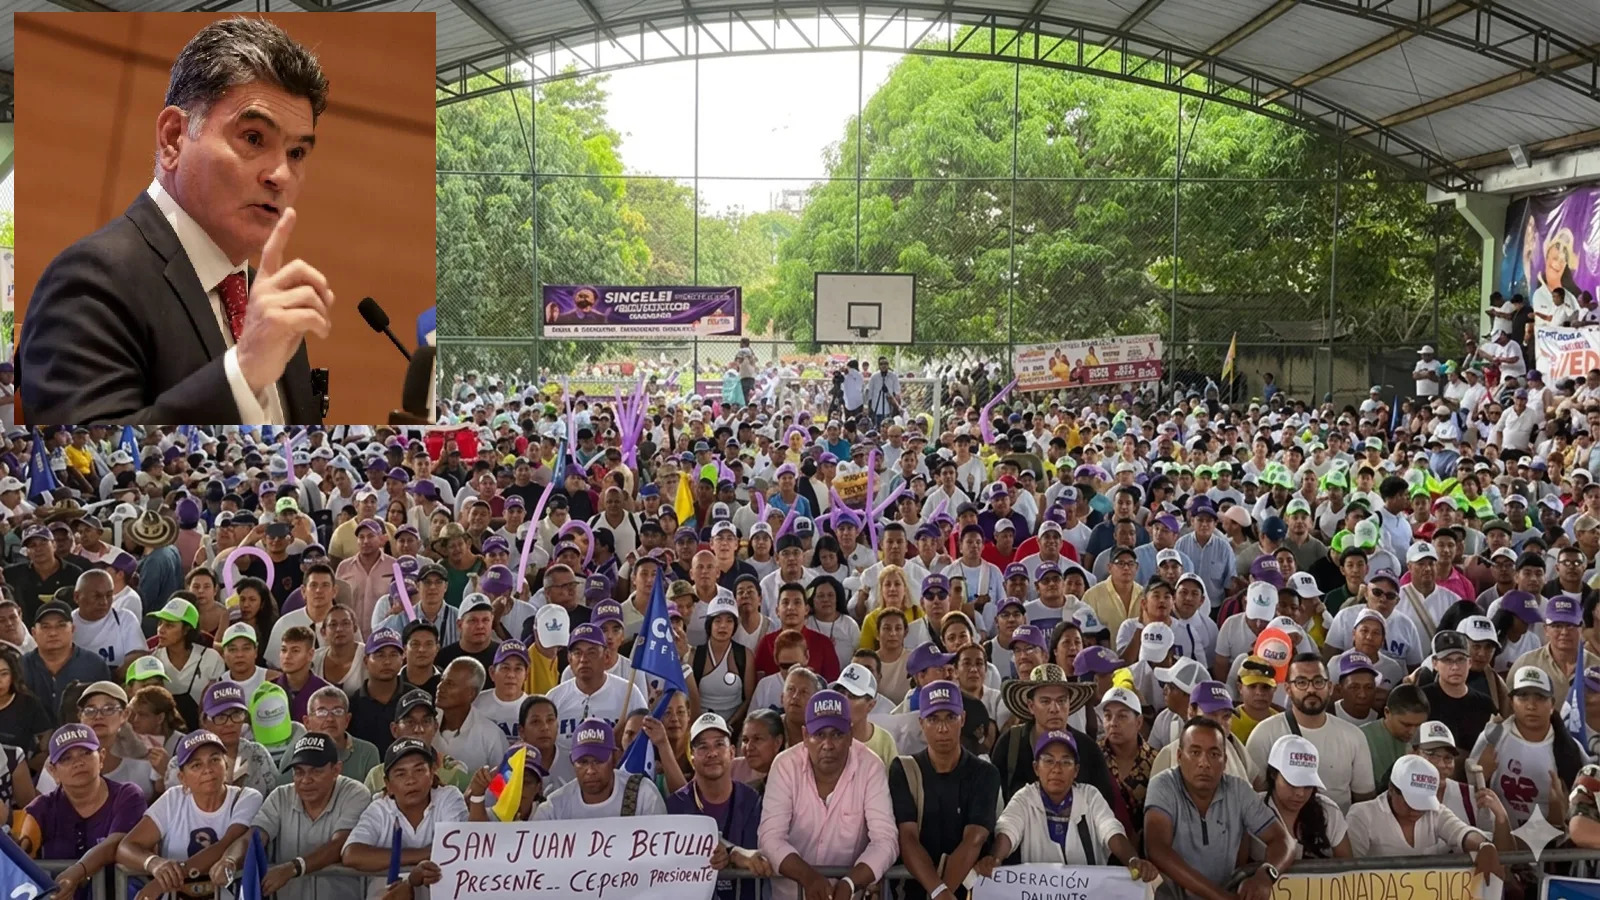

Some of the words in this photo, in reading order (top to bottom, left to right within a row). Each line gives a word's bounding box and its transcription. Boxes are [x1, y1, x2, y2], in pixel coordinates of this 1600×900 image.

[439, 829, 497, 866] SAN
[507, 830, 577, 863] JUAN
[588, 830, 617, 858] DE
[628, 829, 714, 861] BETULIA
